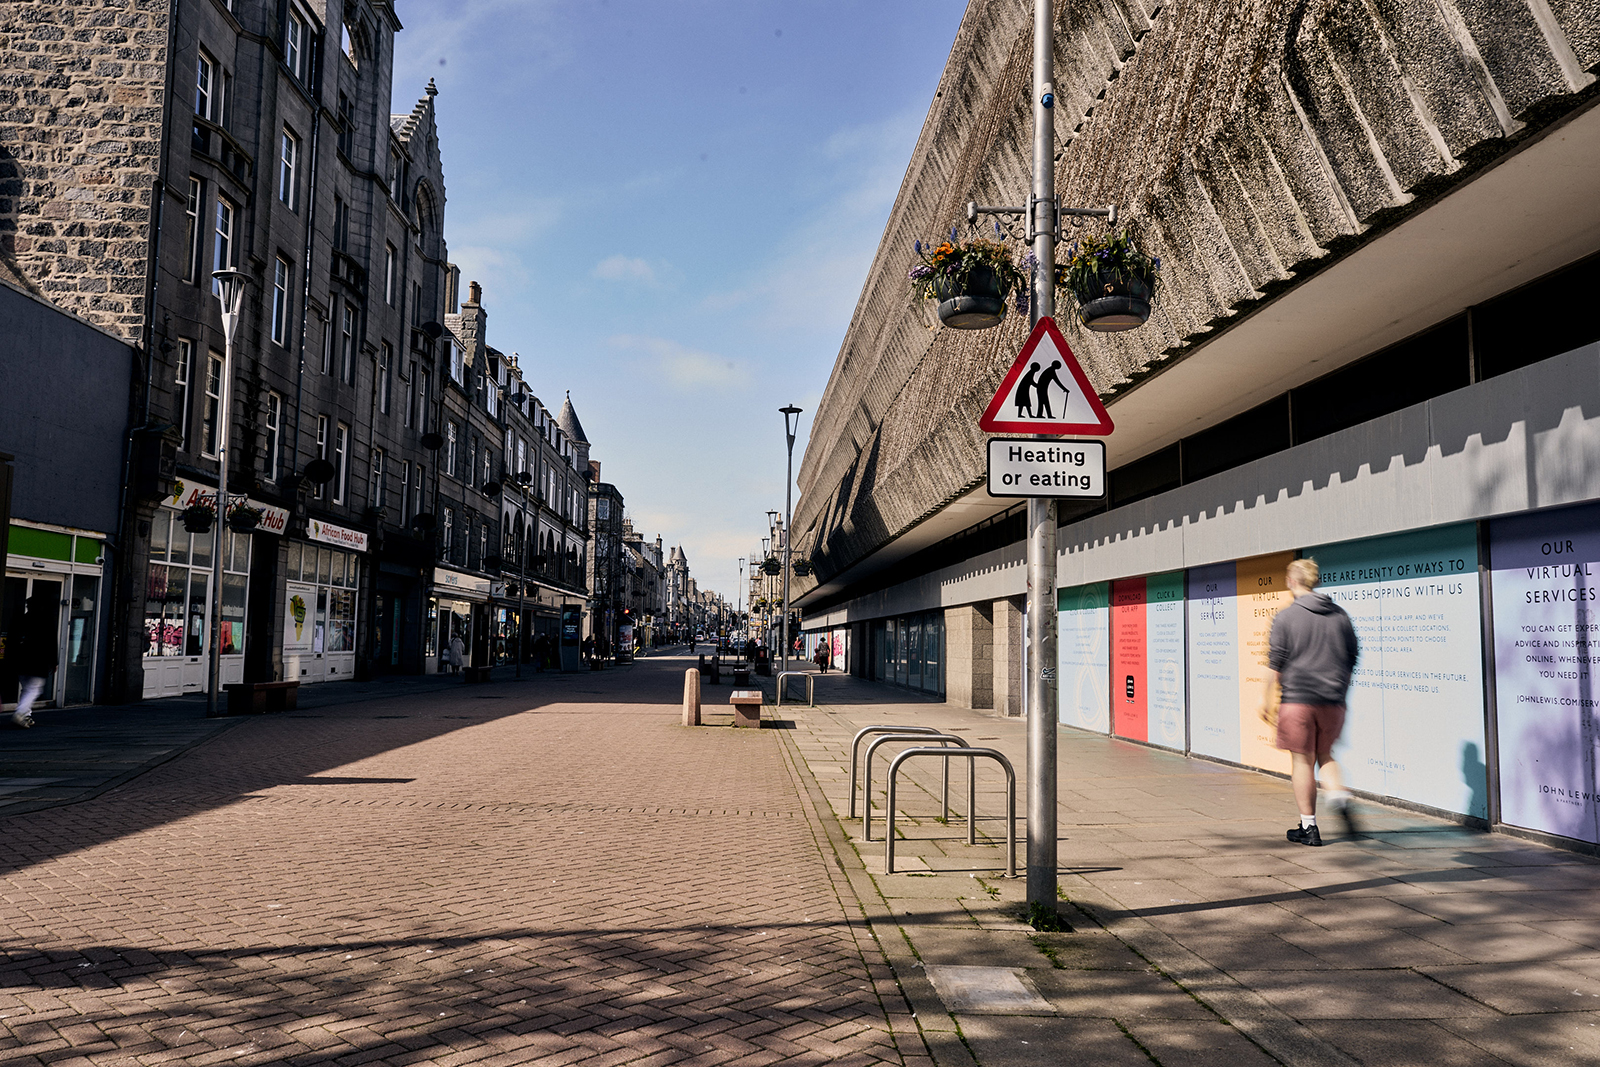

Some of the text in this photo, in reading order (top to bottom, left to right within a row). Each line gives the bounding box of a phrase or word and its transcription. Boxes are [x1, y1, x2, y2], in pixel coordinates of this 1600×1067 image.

[1008, 446, 1085, 466] Heating
[1002, 472, 1090, 490] or eating
[264, 510, 284, 530] Hub
[322, 524, 340, 538] African
[341, 530, 353, 542] Food
[354, 532, 364, 544] Hub
[1541, 540, 1574, 556] OUR
[1318, 559, 1465, 583] HERE ARE PLENTY OF WAYS TO
[1526, 562, 1592, 580] VIRTUAL
[1206, 583, 1218, 592] OUR
[1258, 576, 1273, 587] OUR
[1118, 593, 1141, 602] DOWNLOAD
[1156, 590, 1170, 599] CLICK
[1252, 592, 1280, 602] VIRTUAL
[1362, 586, 1410, 600] SHOPPING
[1415, 584, 1444, 596] WITH
[1448, 582, 1463, 595] US
[1525, 586, 1596, 604] SERVICES
[1156, 602, 1176, 612] COLLECT
[1254, 607, 1279, 618] EVENTS
[1526, 655, 1600, 664] ONLINE, WHENEVER
[1397, 671, 1421, 679] SERVICES
[1372, 682, 1399, 690] WHENEVER
[1414, 685, 1430, 693] NEED
[1367, 758, 1383, 766] JOHN
[1385, 762, 1406, 771] LEWIS
[1539, 784, 1600, 803] JOHN LEWIS
